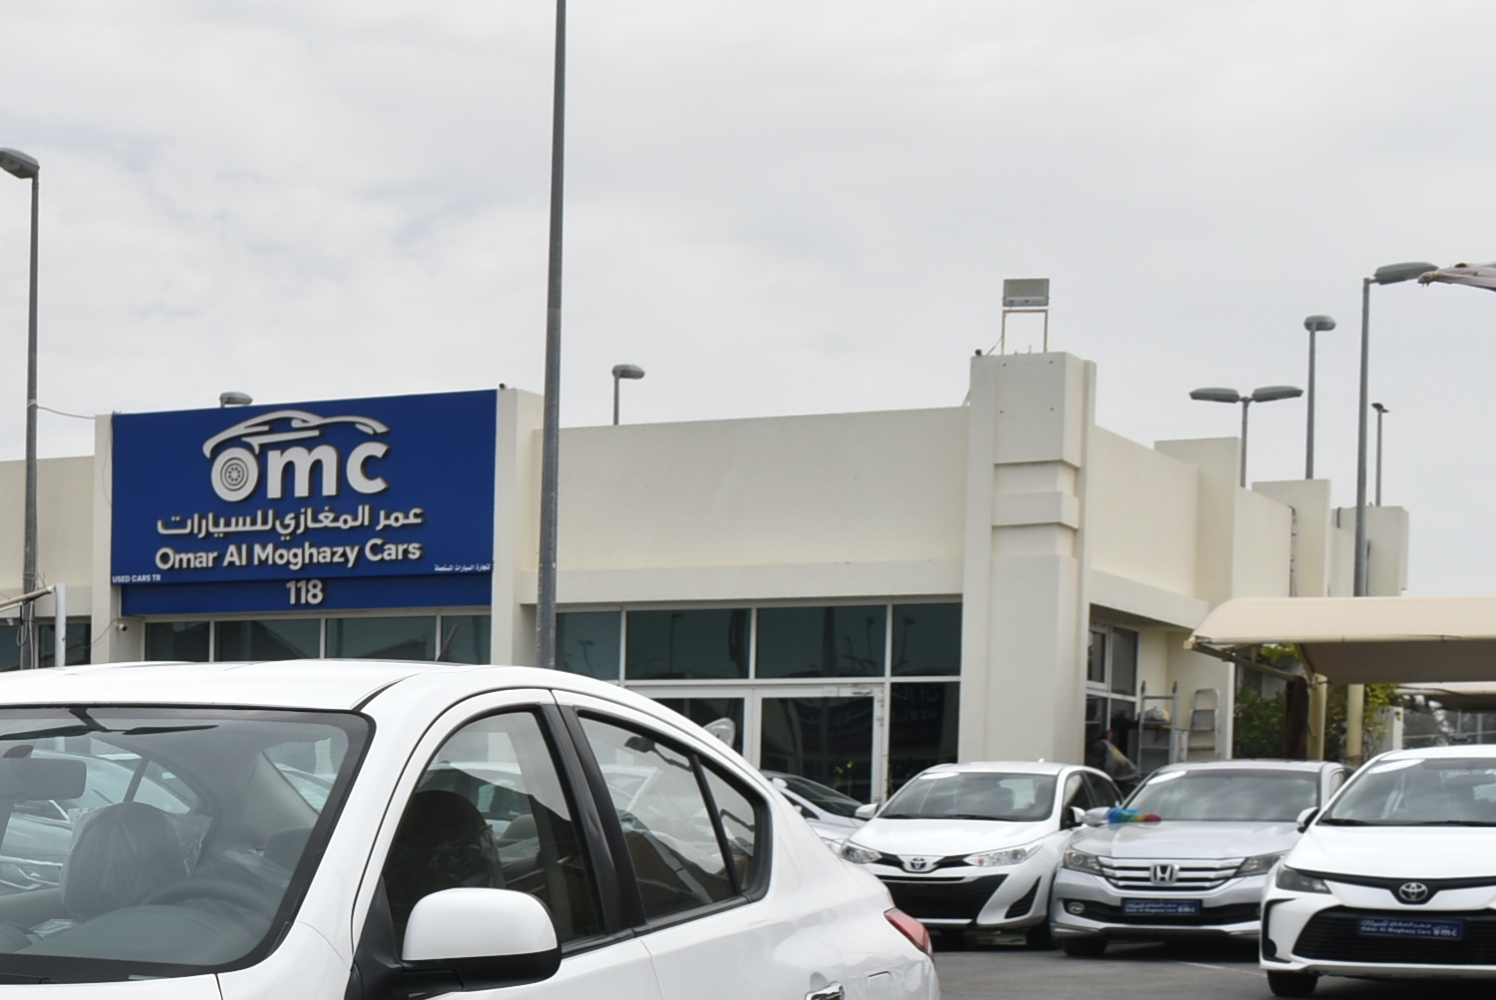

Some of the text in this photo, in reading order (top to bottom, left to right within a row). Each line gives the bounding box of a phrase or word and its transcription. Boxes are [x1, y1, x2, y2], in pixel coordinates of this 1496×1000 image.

[157, 504, 424, 541] عمر المغازي للسيارات
[155, 538, 423, 571] Omar Al Moghazy Cars
[112, 575, 131, 583] USED
[131, 574, 151, 582] CARS
[286, 579, 324, 605] 118
